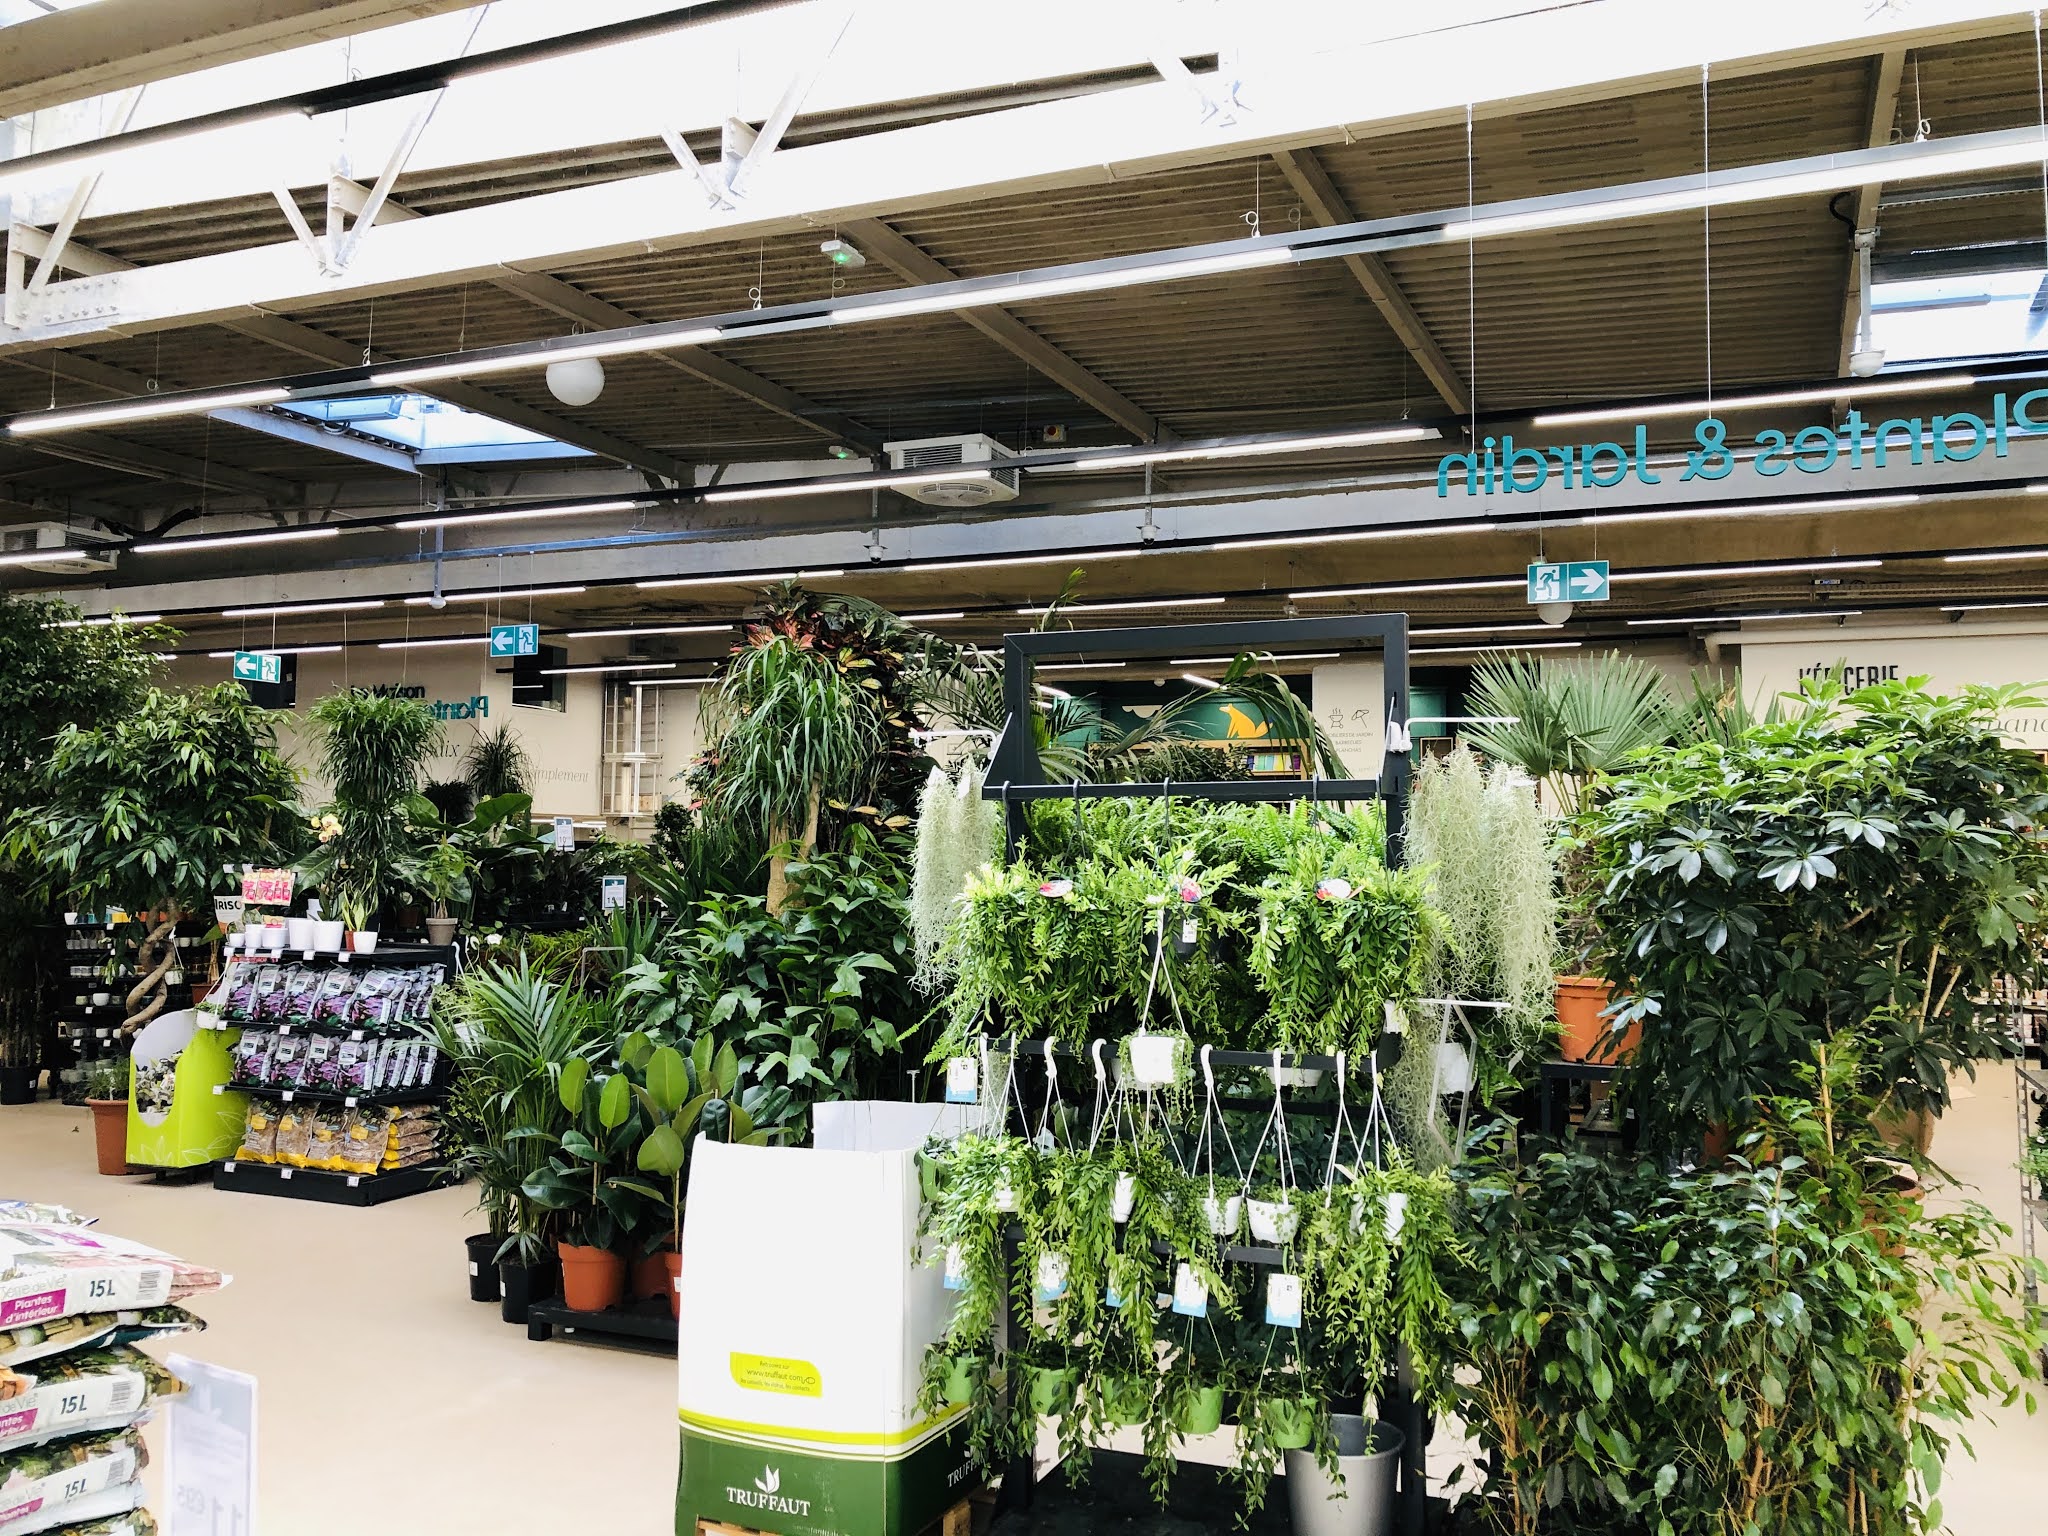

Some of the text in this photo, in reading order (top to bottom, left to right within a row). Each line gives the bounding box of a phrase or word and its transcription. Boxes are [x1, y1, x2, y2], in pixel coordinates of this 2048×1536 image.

[14, 1295, 53, 1310] Plantes
[5, 1304, 59, 1324] d'intérieur
[726, 1486, 811, 1516] TRUFFAUT
